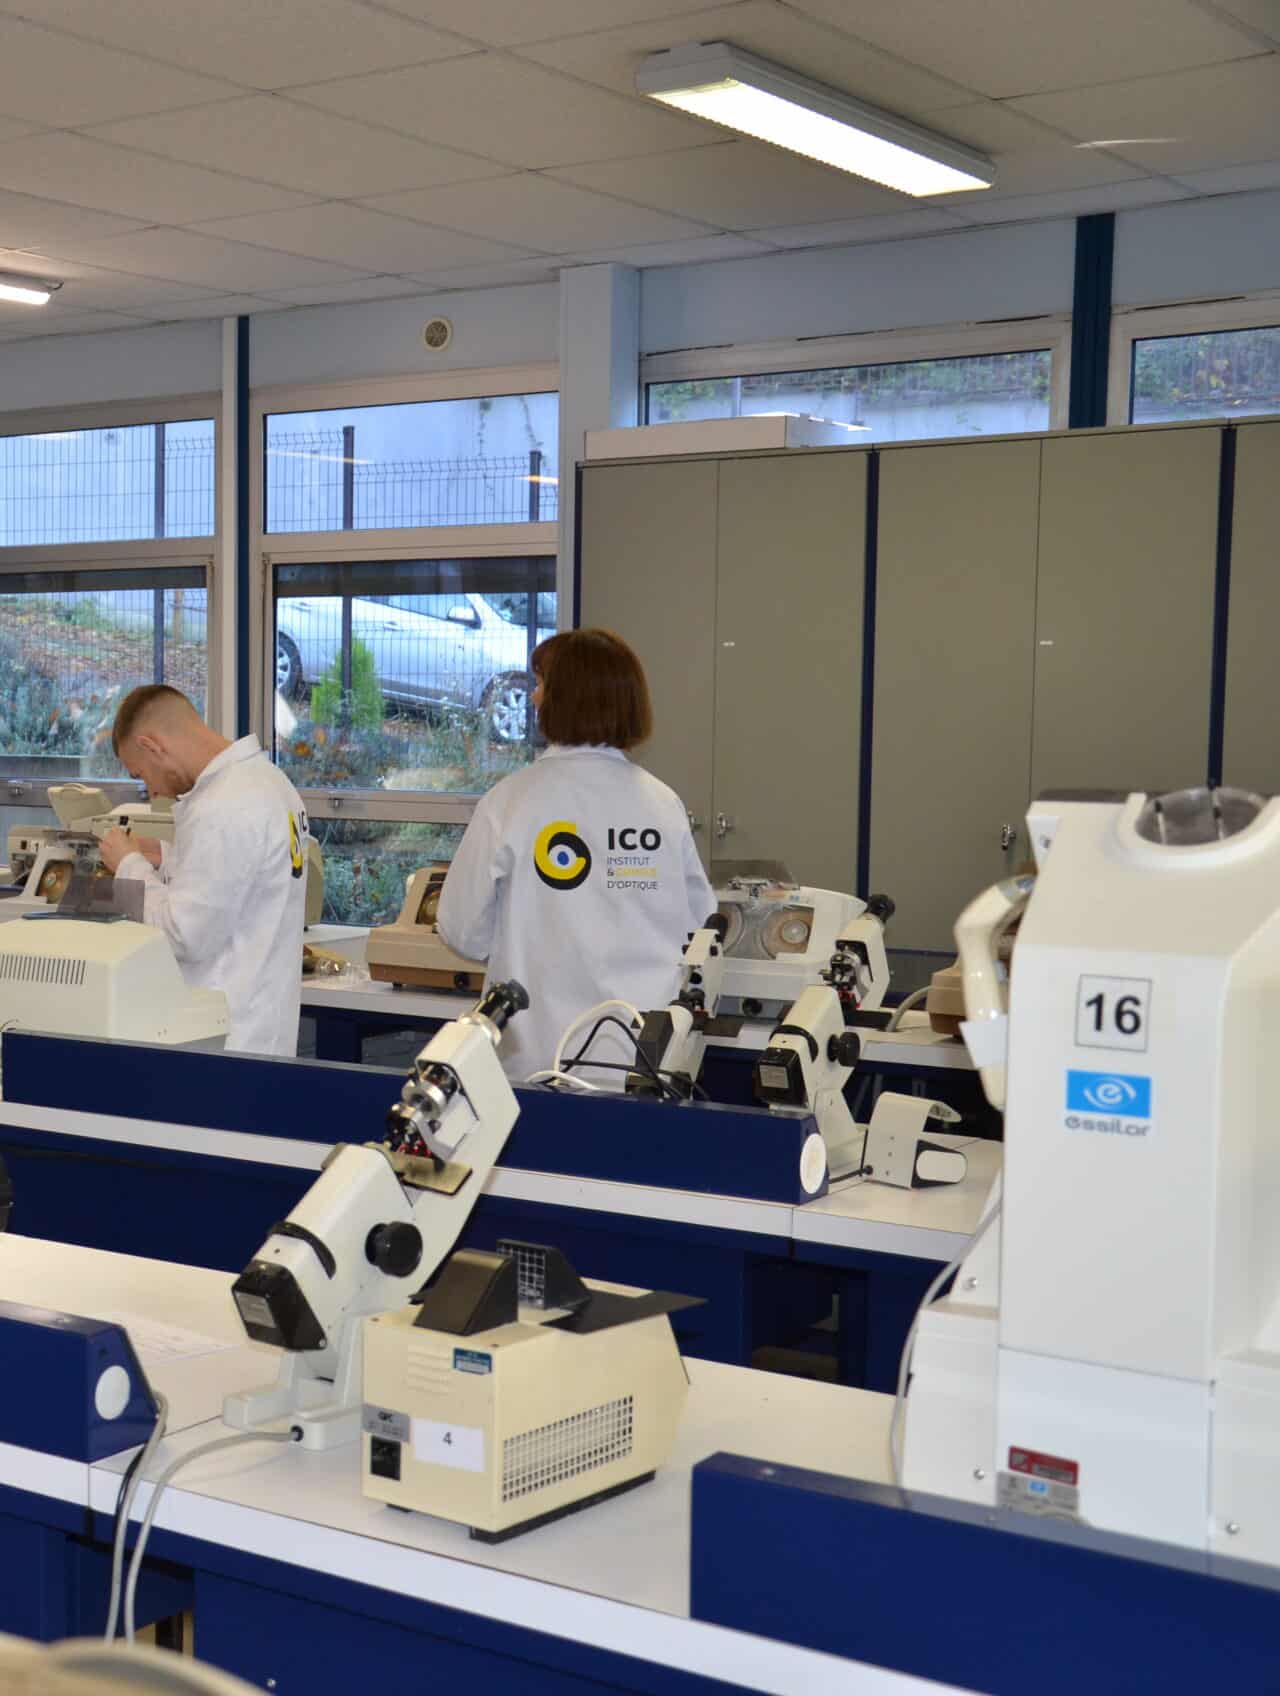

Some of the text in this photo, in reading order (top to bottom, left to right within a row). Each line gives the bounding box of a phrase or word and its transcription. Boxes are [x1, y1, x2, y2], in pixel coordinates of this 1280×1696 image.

[608, 828, 661, 851] ICO
[607, 856, 649, 865] INSTITUT
[607, 881, 657, 890] D'OPTIQUE
[1084, 992, 1142, 1035] 16
[1065, 1115, 1150, 1137] essilor
[443, 1432, 452, 1445] 4
